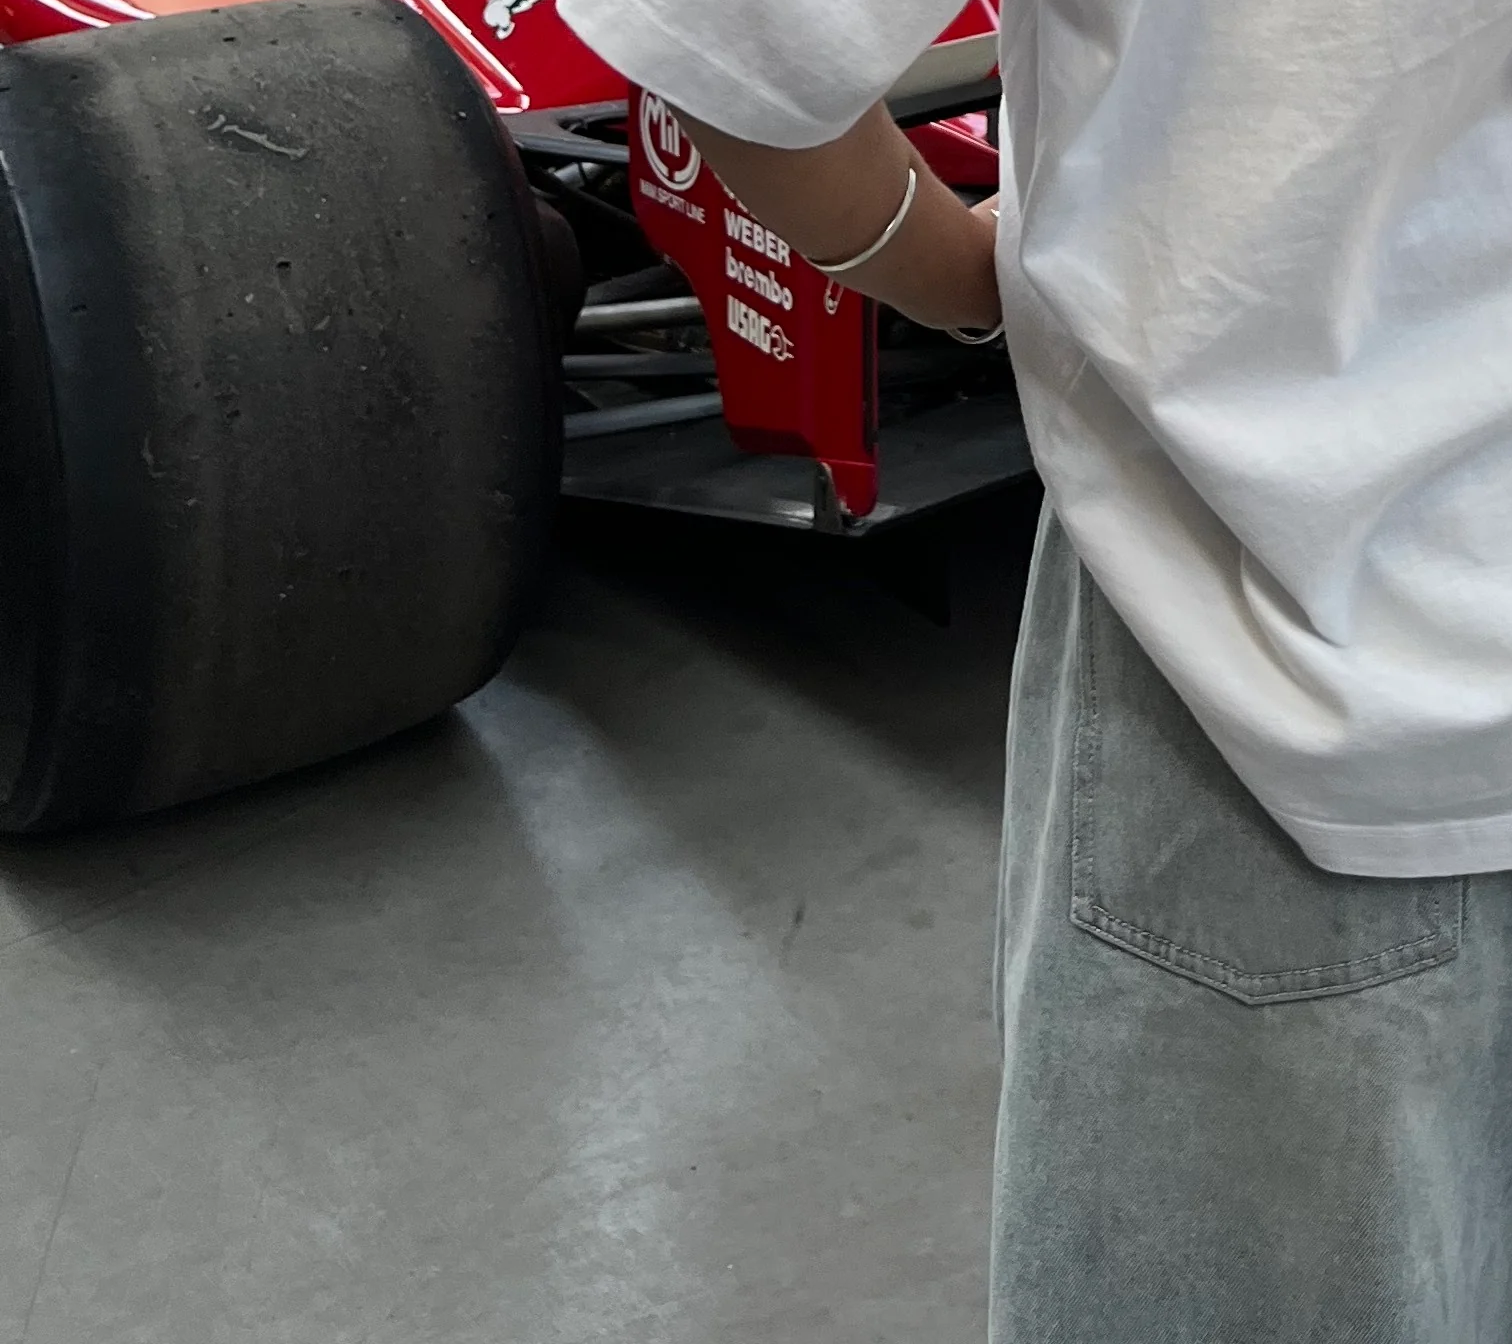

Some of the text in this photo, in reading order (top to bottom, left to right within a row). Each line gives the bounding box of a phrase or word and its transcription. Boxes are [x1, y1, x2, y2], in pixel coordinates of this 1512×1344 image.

[724, 208, 791, 268] WEBER
[725, 246, 793, 311] brembo
[727, 294, 772, 355] USAG
